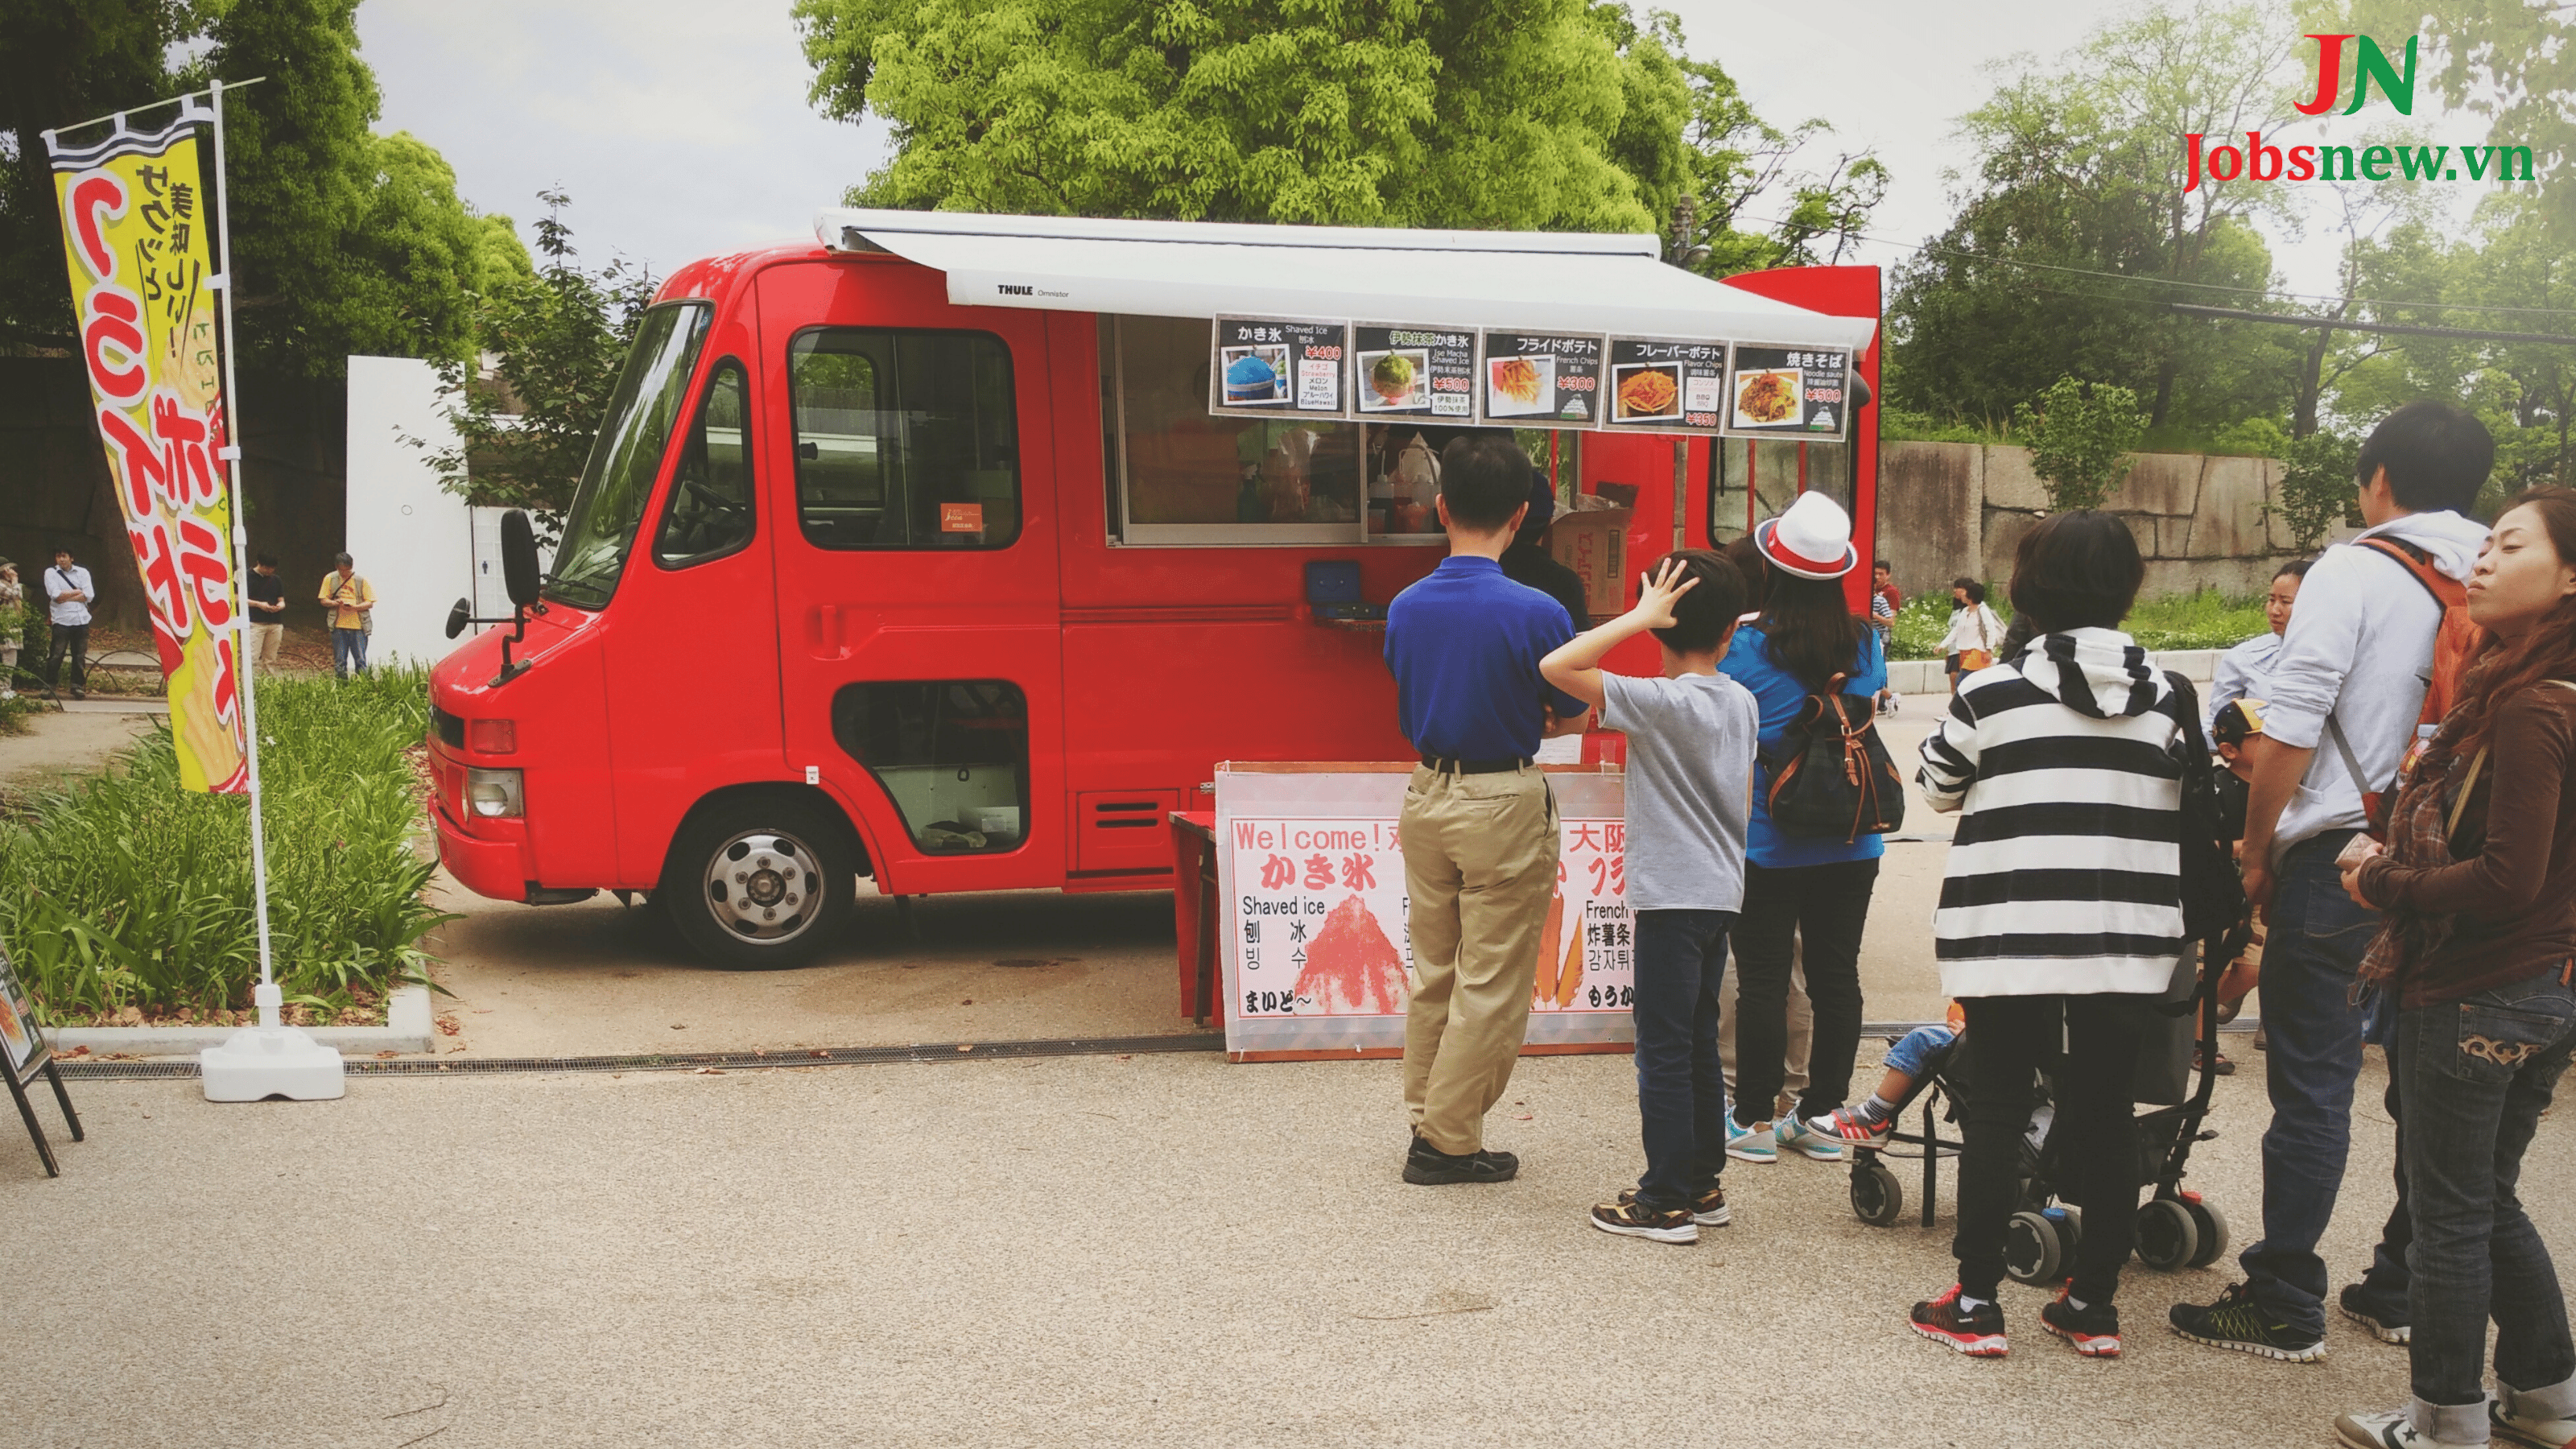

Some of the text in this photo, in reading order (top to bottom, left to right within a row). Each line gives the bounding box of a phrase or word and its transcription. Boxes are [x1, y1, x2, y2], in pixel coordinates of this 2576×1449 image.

[997, 284, 1033, 295] THULE
[1238, 325, 1282, 342] かき氷
[1286, 324, 1327, 335] Shaved Ice
[1389, 330, 1469, 348] 伊勢抹茶かき氷
[1517, 338, 1597, 354] フライドポテト
[1305, 345, 1341, 360] ¥400
[1636, 344, 1720, 360] フレーバーポテト
[1786, 352, 1843, 368] 焼きそば
[1431, 357, 1457, 365] Shaved
[1556, 356, 1599, 366] French Chips
[1683, 360, 1723, 369] Flavor Chips
[1433, 377, 1469, 392] ¥500
[1557, 376, 1596, 392] ¥300
[1805, 388, 1842, 403] ¥500
[1236, 822, 1380, 852] Welcome!
[1260, 852, 1377, 892] かき氷
[1243, 895, 1325, 915] Shaved ice
[1586, 900, 1629, 919] French
[1244, 919, 1307, 944] 刨 冰
[1587, 922, 1630, 947] 炸薯条
[1245, 946, 1307, 971] 빙 수
[1588, 949, 1634, 972] 감자튀
